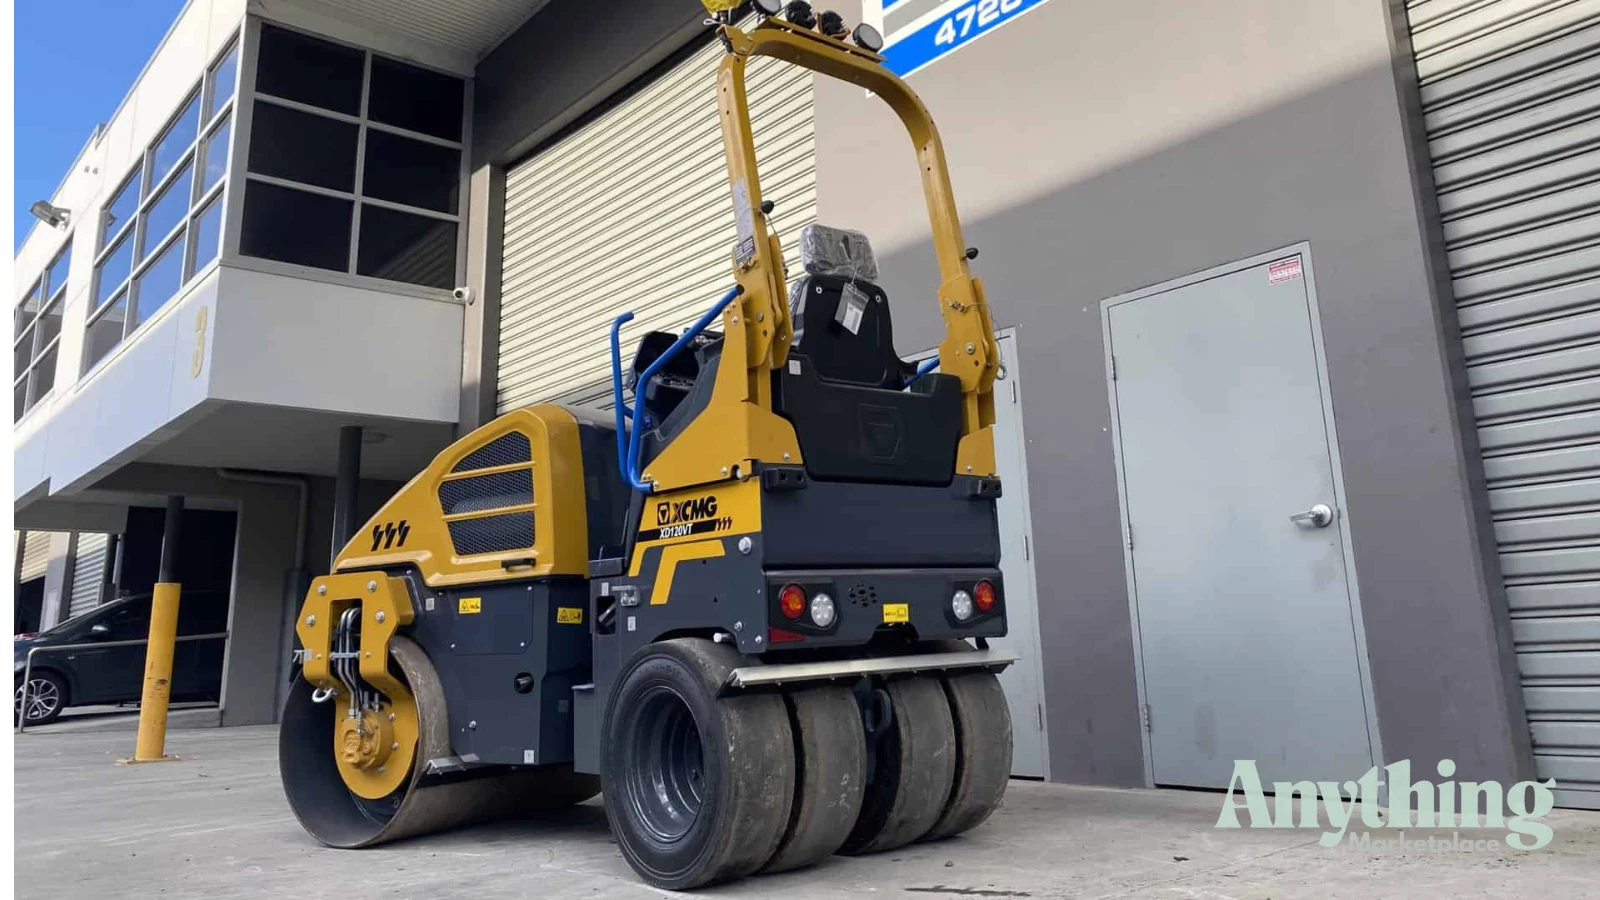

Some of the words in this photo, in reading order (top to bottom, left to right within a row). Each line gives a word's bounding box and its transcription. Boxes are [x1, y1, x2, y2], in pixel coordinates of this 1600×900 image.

[191, 305, 208, 379] 3
[671, 495, 717, 522] XCMG
[659, 523, 693, 539] XD120VT
